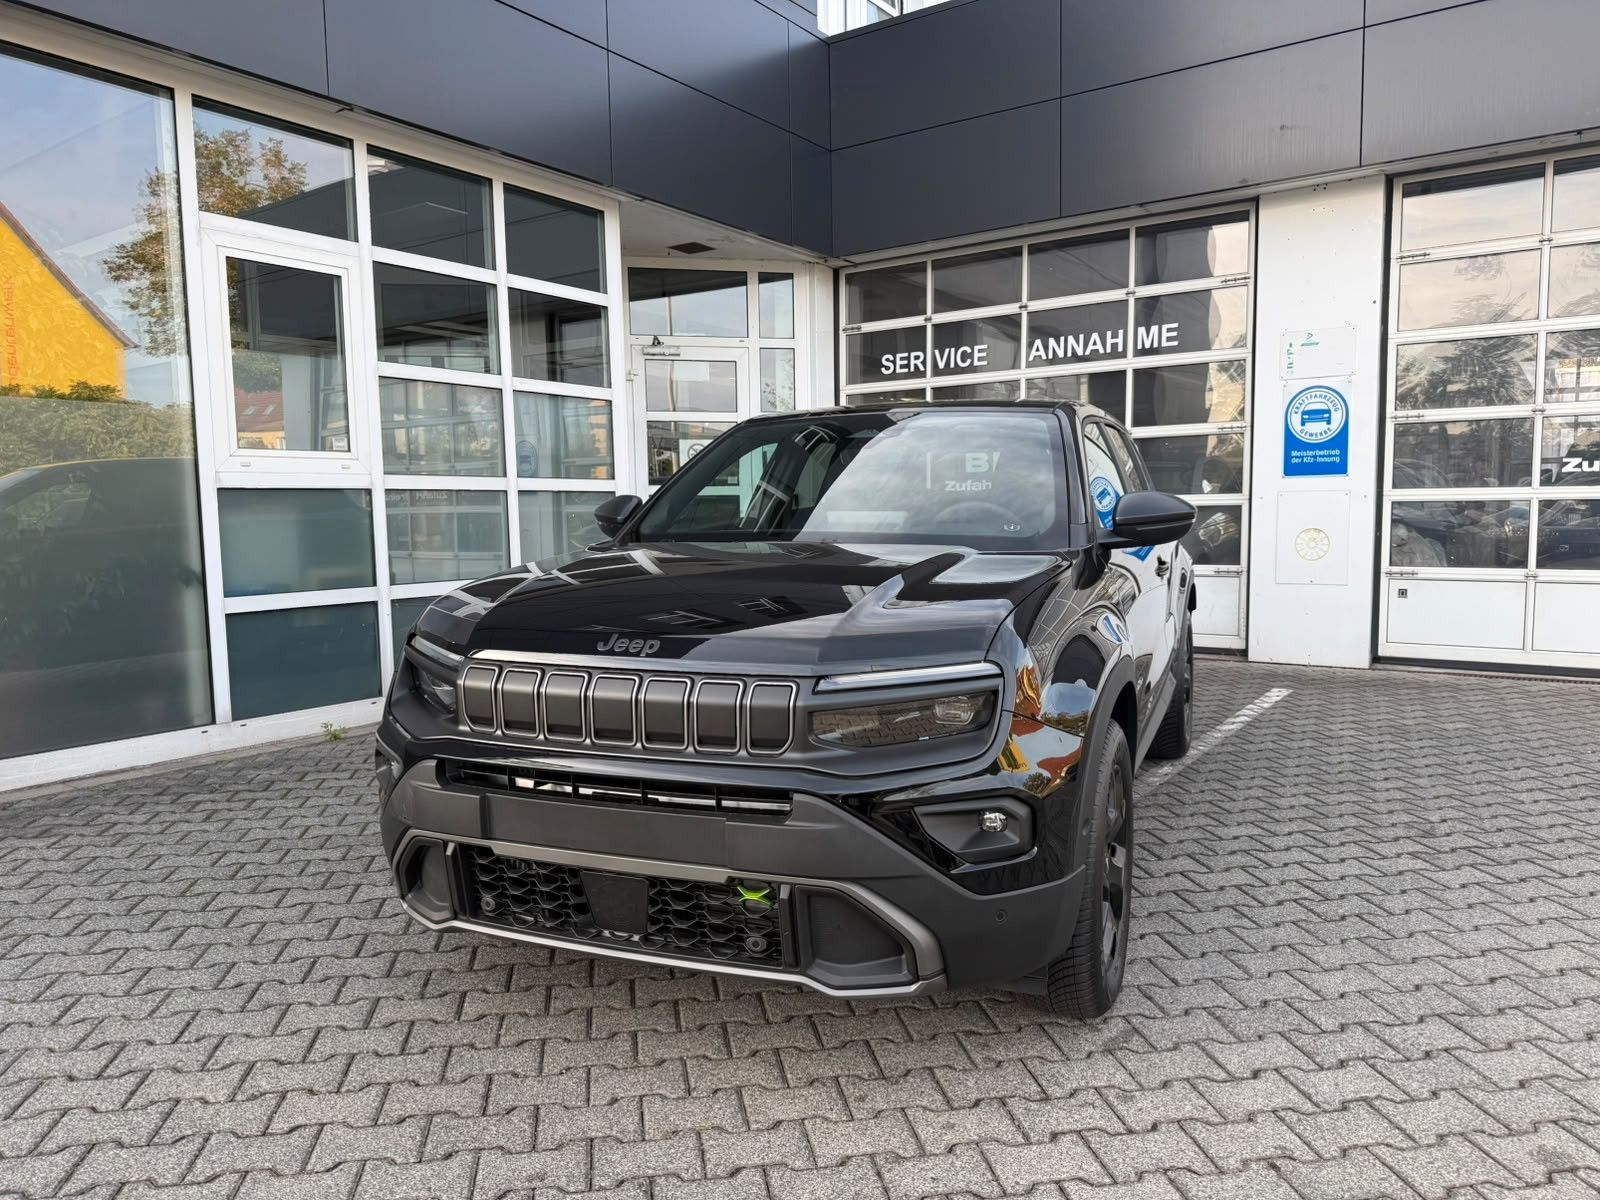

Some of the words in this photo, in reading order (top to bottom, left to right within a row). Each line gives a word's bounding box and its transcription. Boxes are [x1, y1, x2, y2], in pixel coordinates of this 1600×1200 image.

[880, 344, 988, 375] SERVICE
[1028, 322, 1179, 362] ANNAHME
[1293, 393, 1340, 415] KRAFTFAHRZEUG
[1299, 426, 1333, 438] GEWERBE
[1290, 448, 1341, 457] Meisterbetrieb
[1303, 456, 1340, 464] Kfz-Innung
[1561, 457, 1600, 473] Zu
[596, 633, 661, 657] Jeep
